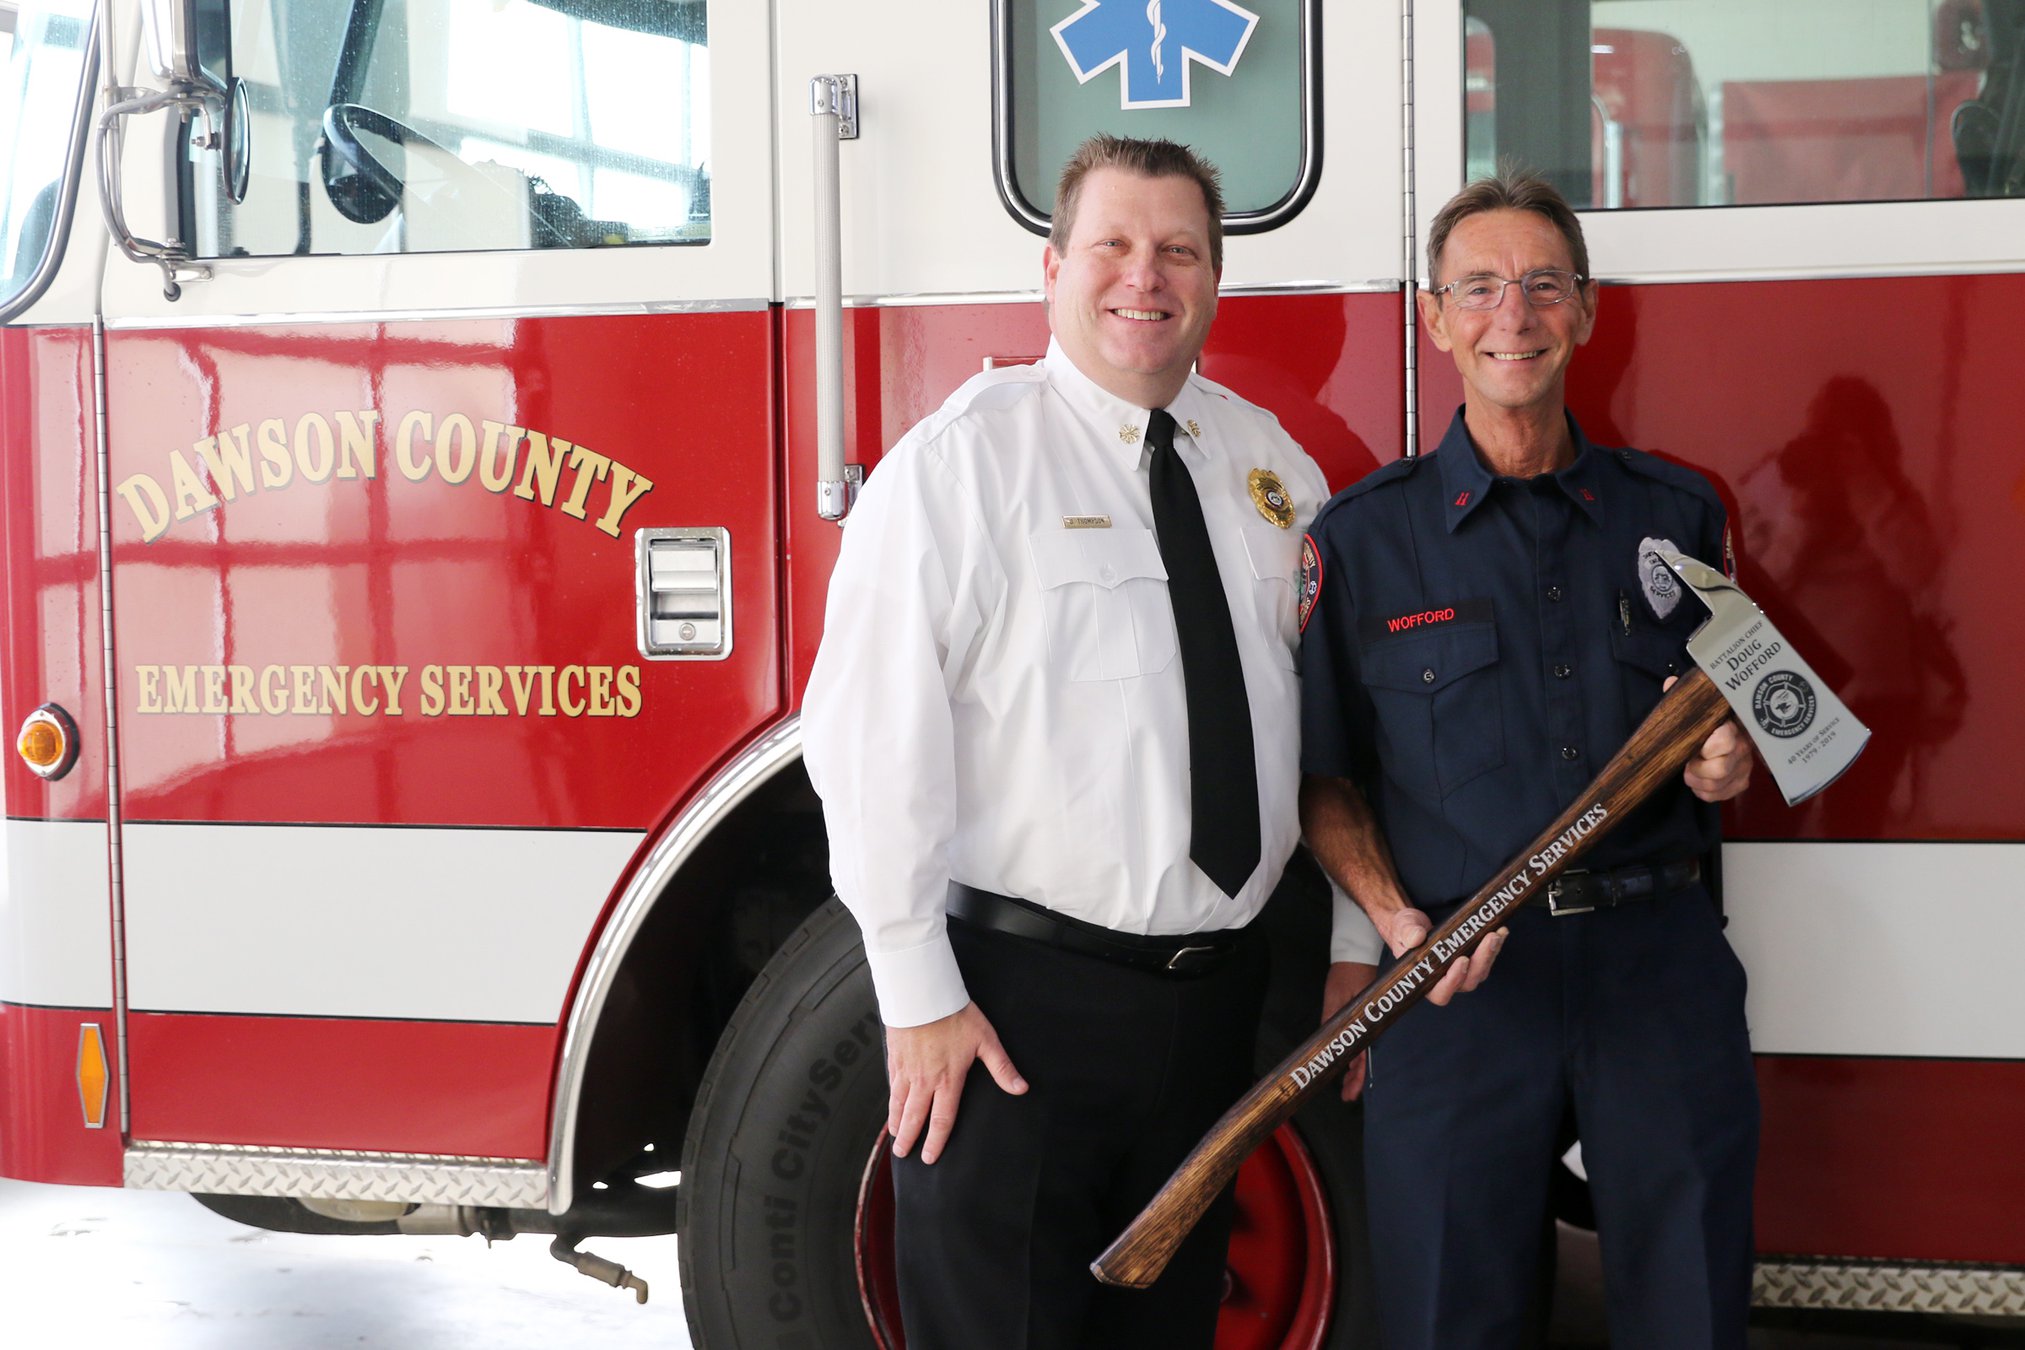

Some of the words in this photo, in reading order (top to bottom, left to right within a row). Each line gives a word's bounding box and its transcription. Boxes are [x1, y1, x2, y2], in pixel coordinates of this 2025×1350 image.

[115, 410, 379, 545] DAWSON
[396, 410, 655, 540] COUNTY
[1386, 607, 1455, 633] WOFFORD
[1709, 636, 1746, 670] BATTALION
[1744, 620, 1763, 639] CHIEF
[1725, 641, 1782, 691] WOFFORD
[1726, 638, 1762, 671] DOUG
[1768, 673, 1794, 684] COUNTY
[135, 664, 408, 717] EMERGENCY
[420, 664, 643, 718] SERVICES
[1289, 1018, 1368, 1090] DAWSON
[1363, 956, 1435, 1024] COUNTY
[1431, 869, 1533, 964] EMERGENCY
[1528, 802, 1609, 877] SERVICES
[764, 1195, 803, 1322] Conti
